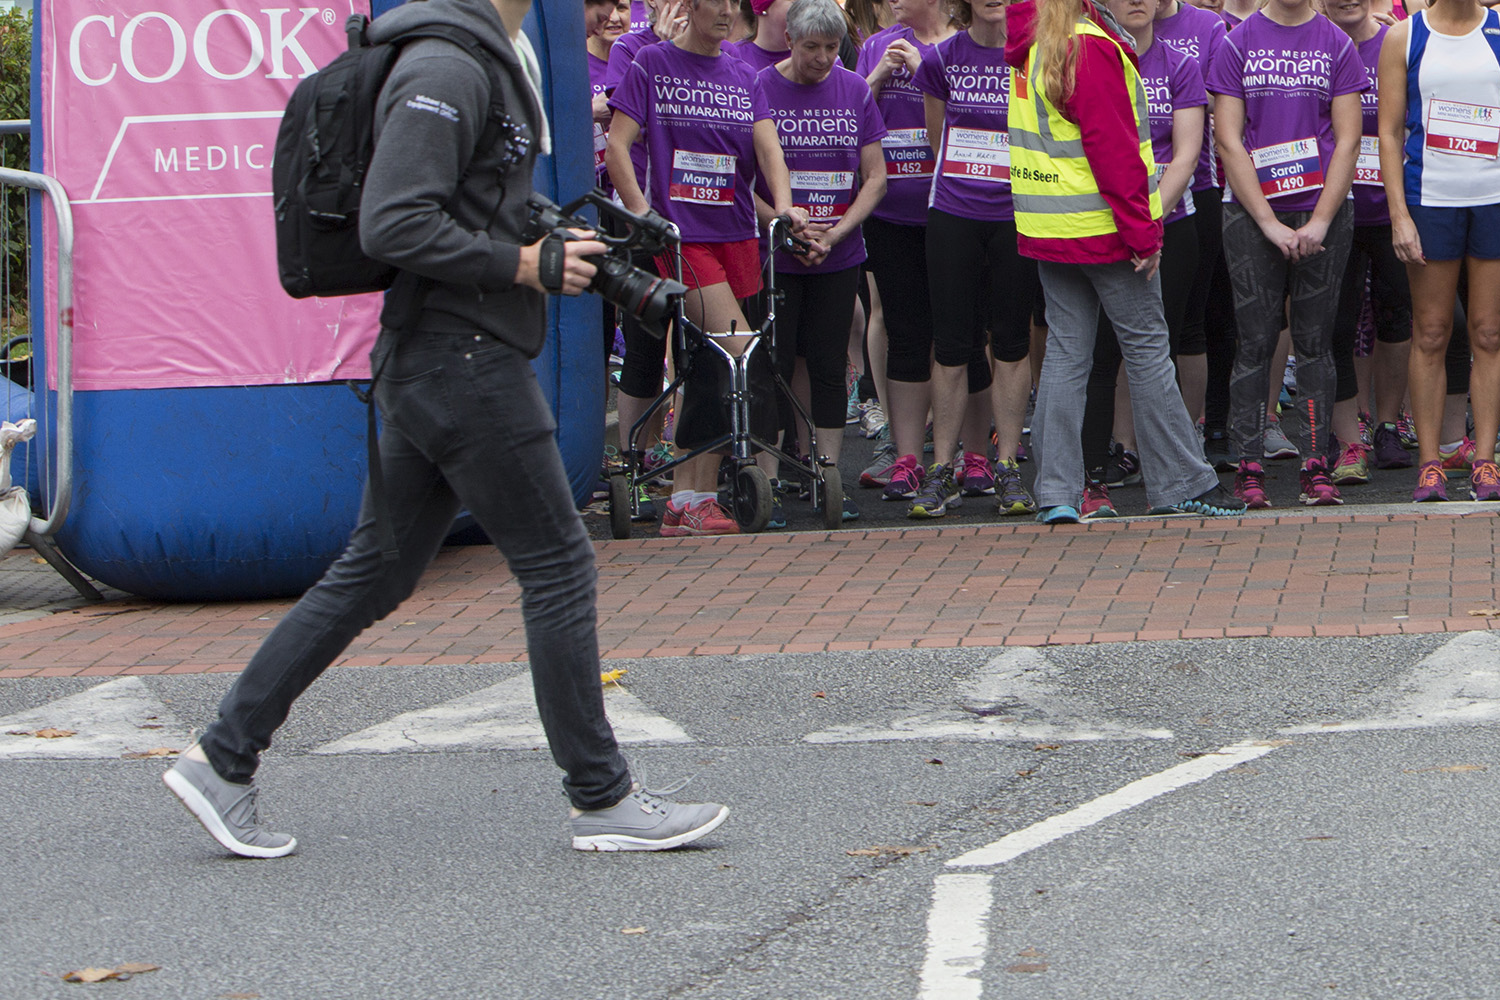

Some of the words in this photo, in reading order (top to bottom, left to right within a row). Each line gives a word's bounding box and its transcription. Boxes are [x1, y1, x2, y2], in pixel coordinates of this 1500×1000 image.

[1248, 49, 1275, 58] OOK
[1282, 50, 1333, 62] MEDICAL
[946, 65, 978, 74] COOK
[654, 74, 690, 87] COOK
[697, 81, 750, 95] MEDICAL
[945, 74, 1010, 91] wome
[1268, 74, 1330, 90] MARATHON
[655, 85, 752, 110] womens
[967, 92, 1010, 103] MARAT
[655, 103, 681, 114] MINI
[684, 105, 754, 122] MARATHON
[769, 108, 797, 117] OOK
[803, 108, 857, 117] MEDICAL
[1438, 105, 1472, 115] womens
[702, 123, 730, 131] LIMERICK
[791, 135, 858, 147] MARATHON
[956, 133, 989, 141] womens
[1448, 137, 1477, 151] 1704
[154, 144, 276, 173] MEDIC
[888, 149, 927, 160] Valerie
[1258, 147, 1289, 159] womens
[681, 155, 715, 165] womens
[896, 162, 922, 174] 1452
[965, 163, 992, 176] 1821
[1011, 166, 1021, 178] afe
[1033, 170, 1059, 183] Seen
[1270, 162, 1304, 178] Sarah
[682, 172, 713, 187] Mary
[1275, 176, 1304, 192] 1490
[691, 186, 720, 201] 1393
[808, 192, 836, 205] Mary
[808, 205, 834, 217] 1389
